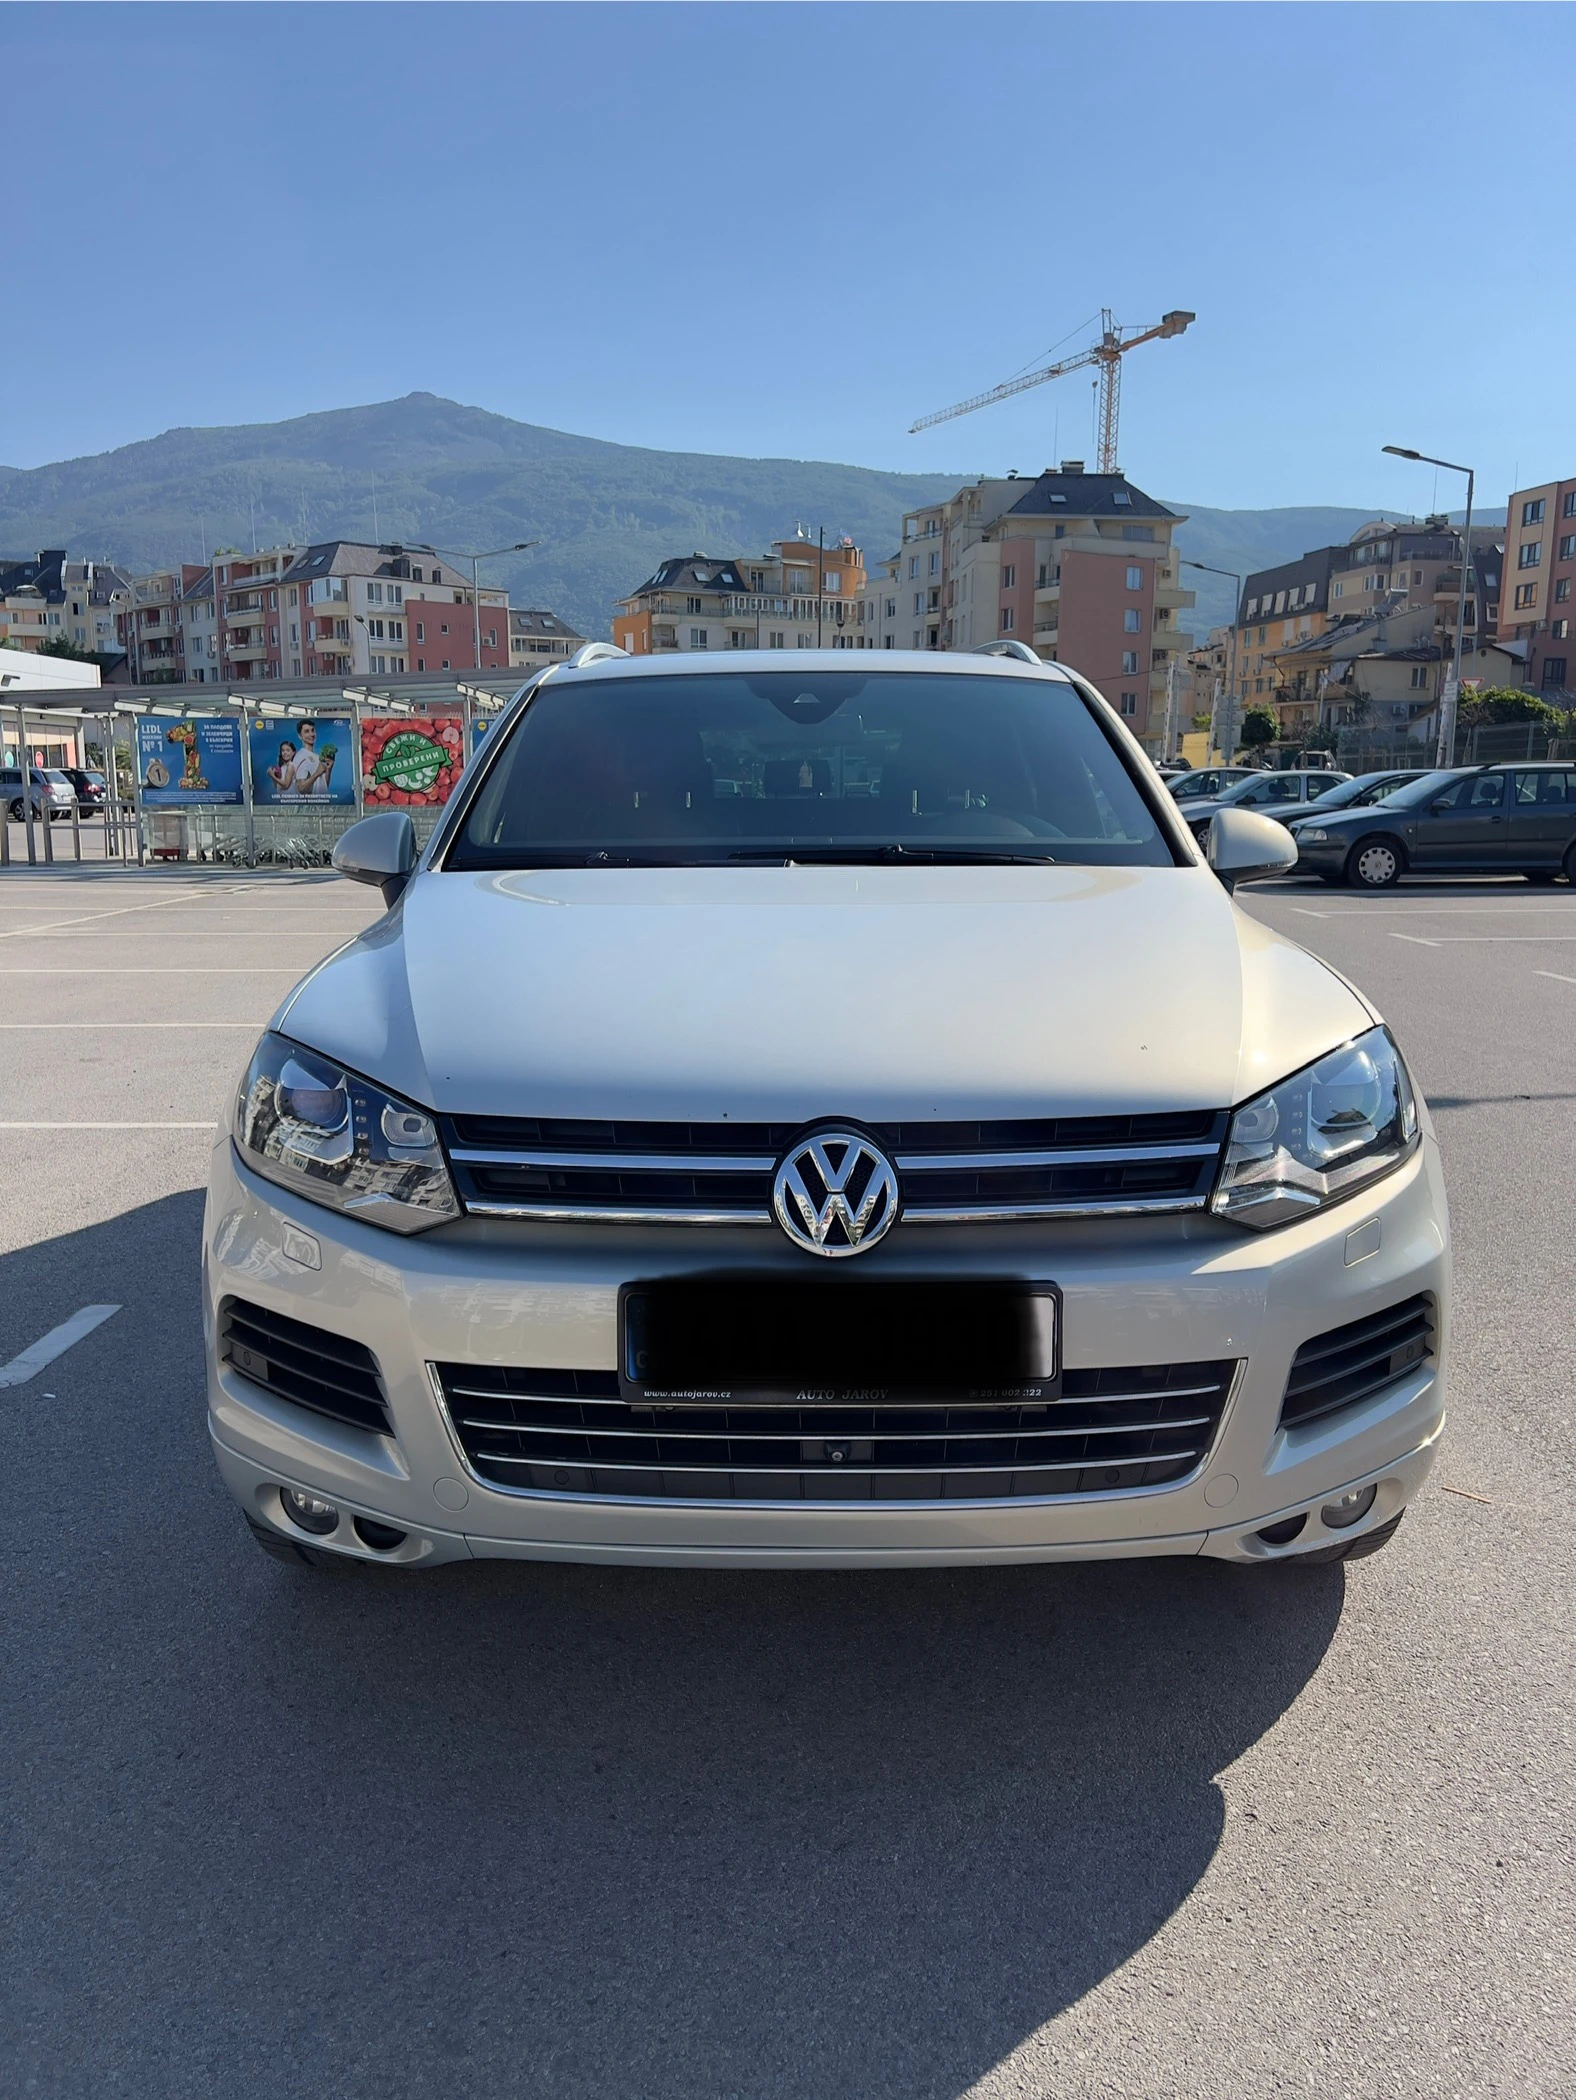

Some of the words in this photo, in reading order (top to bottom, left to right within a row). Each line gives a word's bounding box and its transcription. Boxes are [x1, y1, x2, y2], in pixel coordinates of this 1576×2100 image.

[141, 725, 162, 734] LIDL
[385, 734, 416, 754] СВЕЖИ
[419, 736, 427, 745] И
[382, 751, 439, 773] ПРОВЕРЕНИ
[155, 768, 161, 782] 1
[774, 1133, 898, 1257] VW
[644, 1390, 731, 1399] www.autojarov.cz
[796, 1389, 835, 1400] AUTO
[841, 1389, 889, 1400] JAROV
